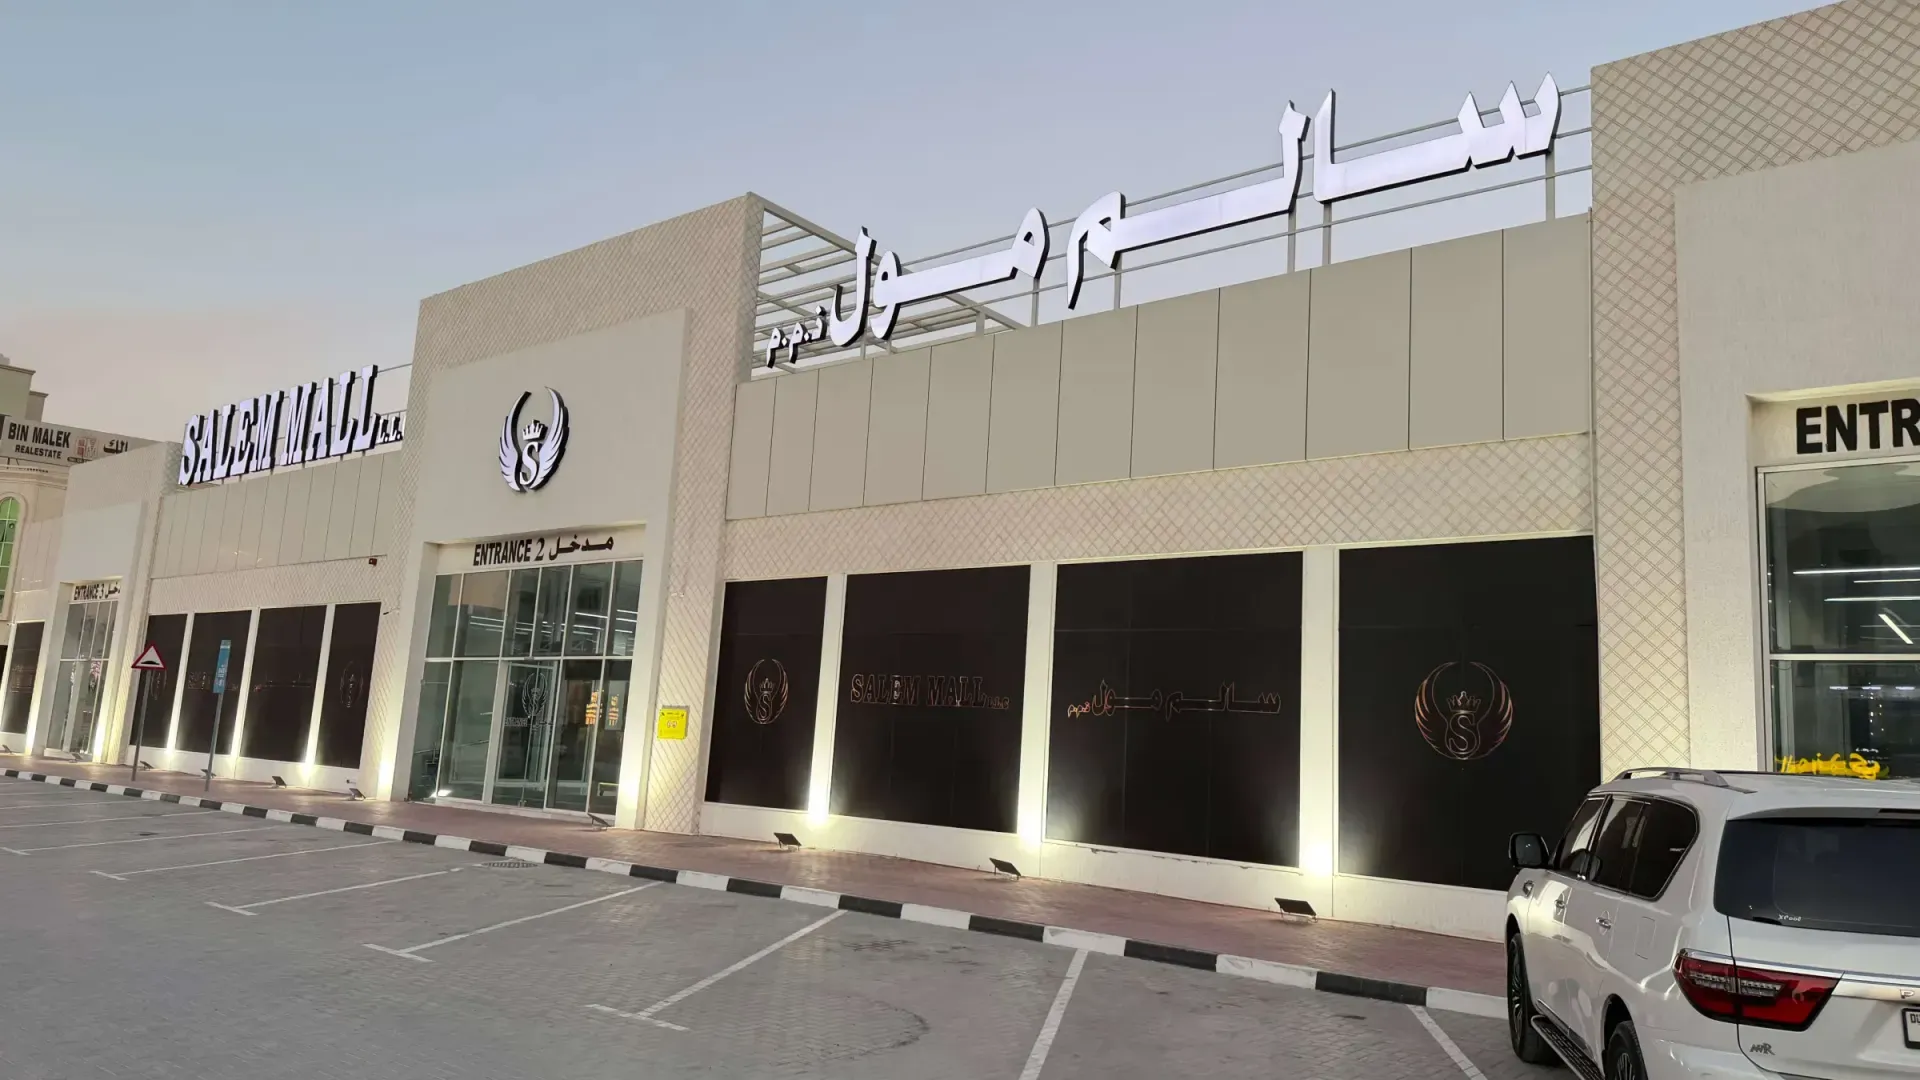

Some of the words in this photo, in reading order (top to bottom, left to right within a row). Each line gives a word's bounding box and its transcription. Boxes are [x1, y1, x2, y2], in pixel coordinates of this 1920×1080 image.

[1067, 72, 1561, 309] سالم
[830, 207, 1050, 348] مول
[8, 422, 29, 440] BIN
[32, 426, 72, 449] MALEK
[178, 390, 285, 487] SALEM
[280, 365, 380, 465] MALL
[375, 411, 407, 445] L.L.
[1795, 399, 1920, 455] ENTR
[14, 444, 62, 459] REALESTATE
[473, 538, 532, 566] ENTRANCE
[534, 537, 545, 561] 2
[548, 534, 614, 561] مدخل
[850, 673, 921, 706] SALEM
[927, 675, 986, 708] MALL
[1092, 679, 1163, 717] مول
[1165, 681, 1282, 722] سالم
